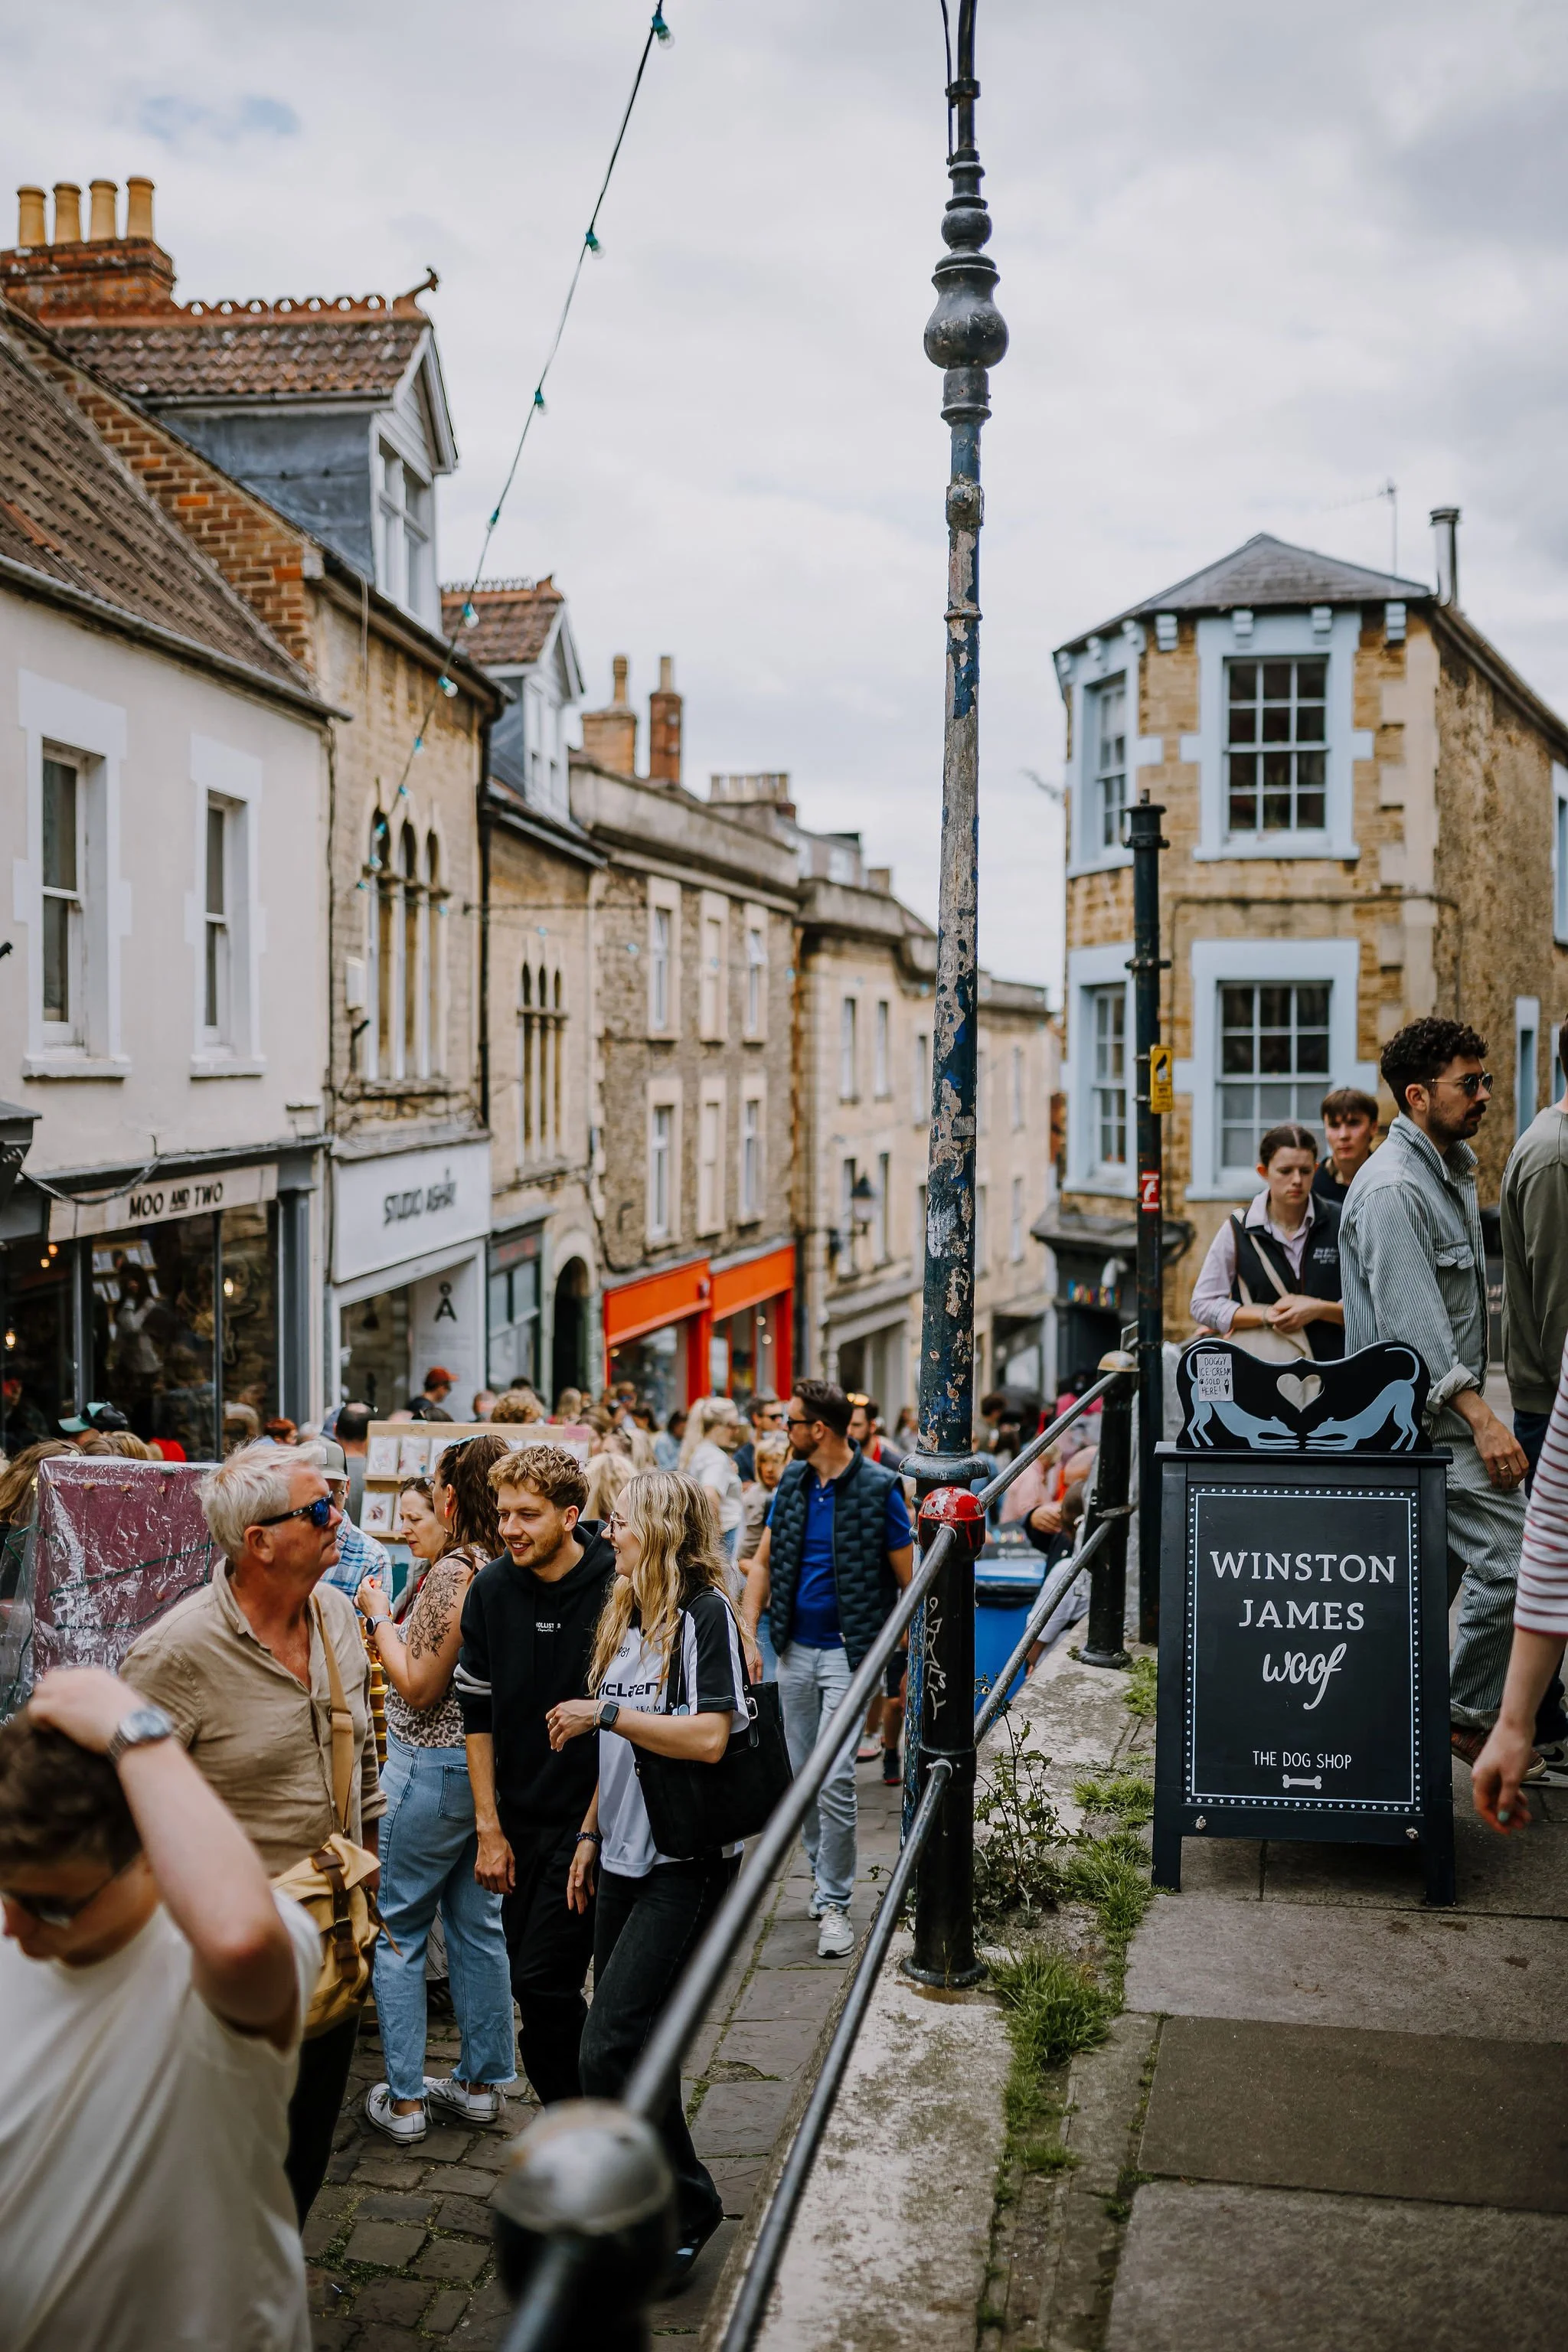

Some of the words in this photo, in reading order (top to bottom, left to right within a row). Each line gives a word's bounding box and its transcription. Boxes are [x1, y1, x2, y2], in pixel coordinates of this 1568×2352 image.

[129, 1192, 164, 1220] MOO
[170, 1188, 190, 1205] AND
[195, 1181, 224, 1207] TWO
[1204, 1357, 1227, 1366] DOGGY
[1210, 1550, 1396, 1583] WINSTON
[1239, 1599, 1364, 1630] JAMES
[1263, 1643, 1348, 1710] woof
[1253, 1750, 1277, 1766] THE
[1282, 1752, 1311, 1767] DOG
[1316, 1753, 1352, 1769] SHOP
